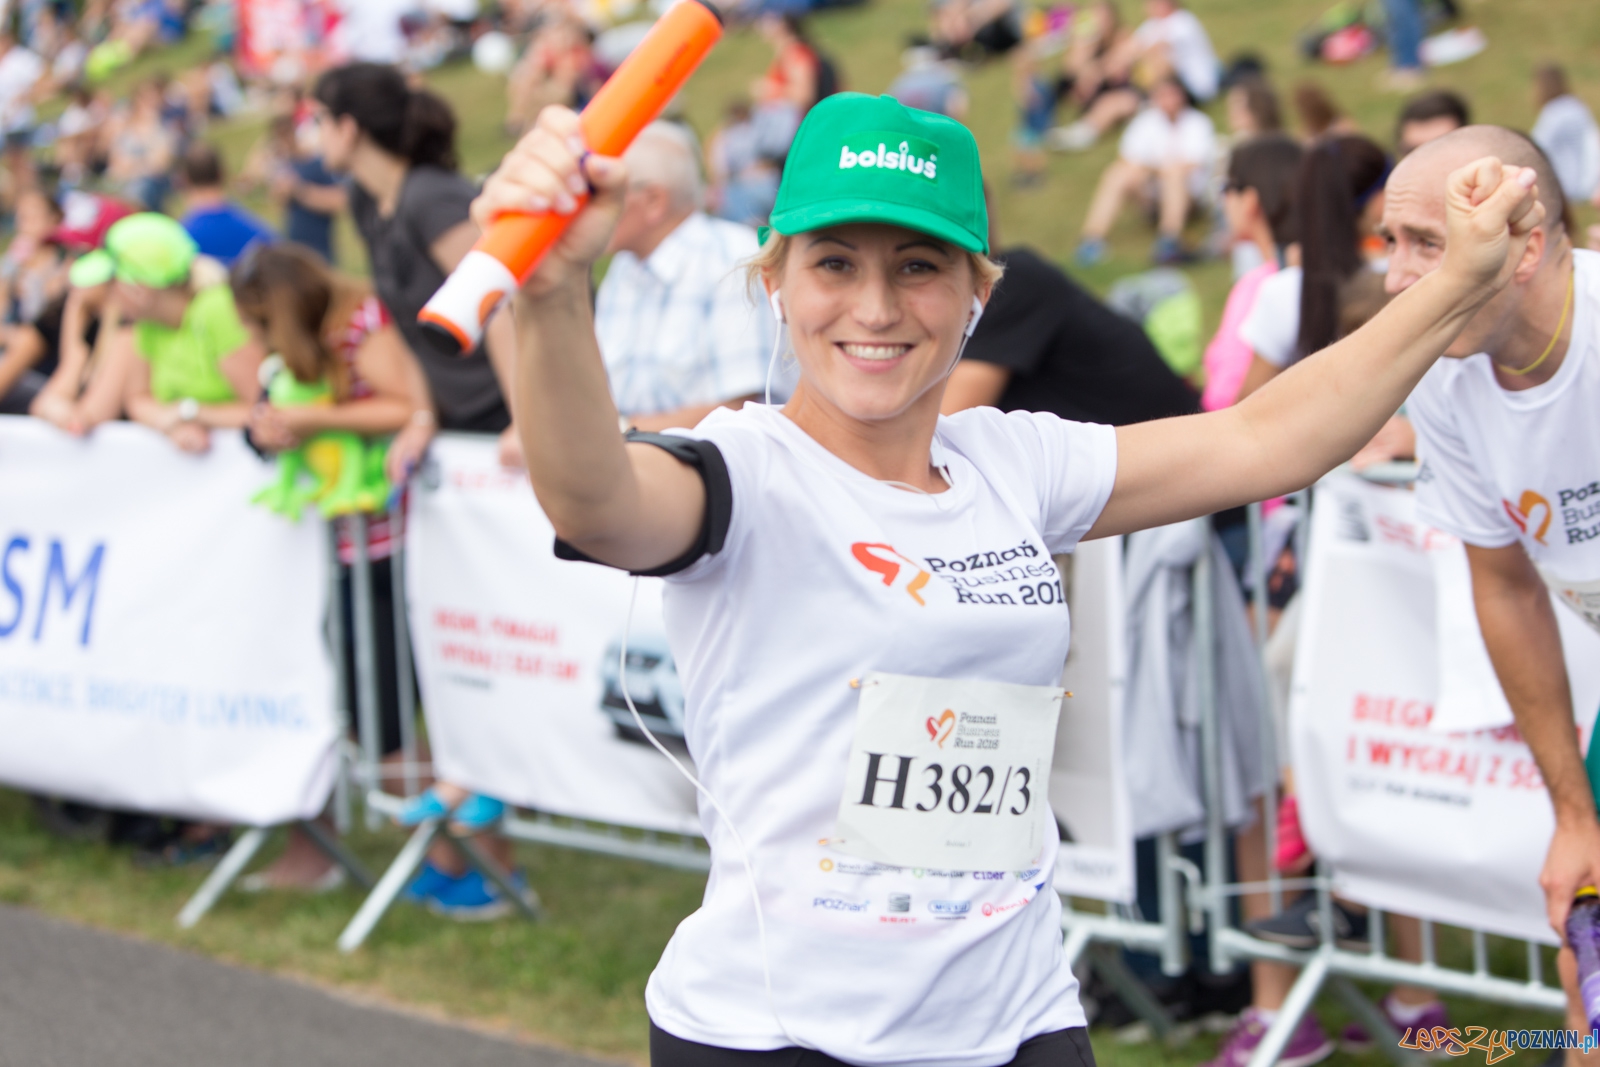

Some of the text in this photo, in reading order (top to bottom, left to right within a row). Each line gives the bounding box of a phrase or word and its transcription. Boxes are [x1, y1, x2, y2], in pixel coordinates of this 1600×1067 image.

[839, 141, 937, 179] bolsius
[923, 540, 1039, 573] Poznań
[952, 586, 1018, 606] Run
[954, 738, 975, 749] Run
